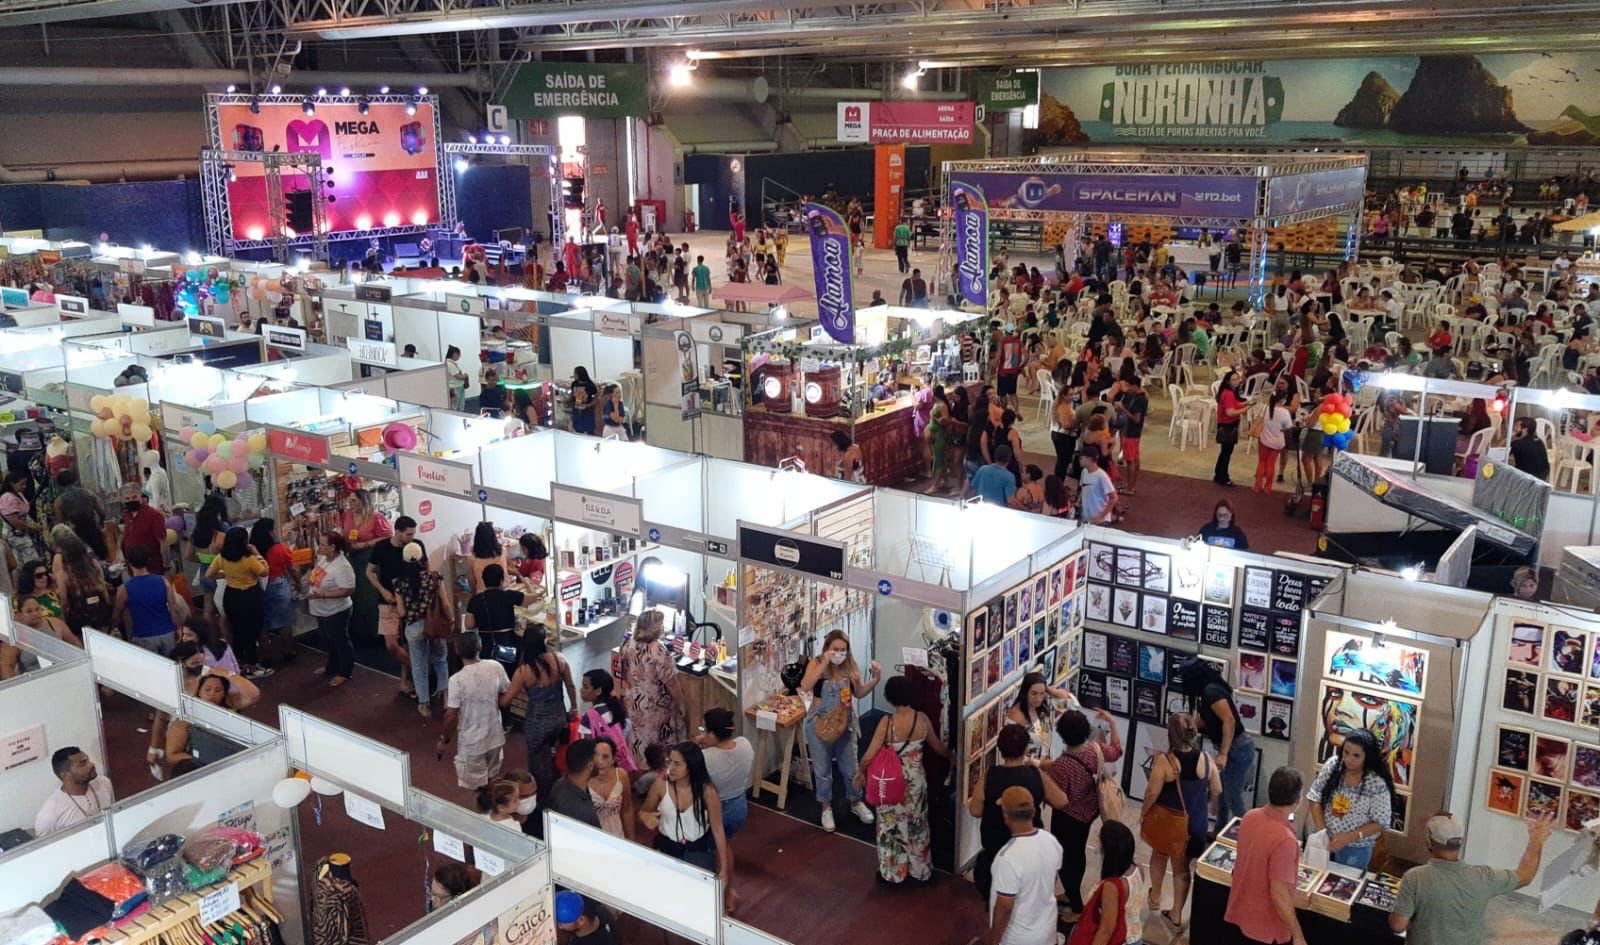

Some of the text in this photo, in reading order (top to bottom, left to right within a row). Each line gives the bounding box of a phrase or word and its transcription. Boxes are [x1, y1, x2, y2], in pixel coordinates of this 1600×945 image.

[545, 72, 606, 88] SAÍDA DE
[534, 90, 619, 107] EMERGÊNCIA
[1112, 75, 1266, 125] NORONHA
[492, 108, 503, 130] C
[335, 121, 380, 135] MEGA
[872, 126, 969, 141] PRAÇA DE ALIMENTAÇÃO
[1138, 126, 1155, 137] ESTÁ
[1155, 127, 1164, 137] DE
[1167, 127, 1194, 137] PORTAS
[1194, 127, 1227, 137] ABERTAS
[1227, 127, 1243, 137] PRA
[1079, 188, 1176, 203] SPACEMAN
[1279, 573, 1303, 587] Deus
[1207, 608, 1229, 617] NUNCA
[1275, 599, 1300, 612] todo
[1207, 616, 1228, 626] SORTE
[1205, 633, 1228, 644] DEUS
[505, 904, 547, 944] Caicó
